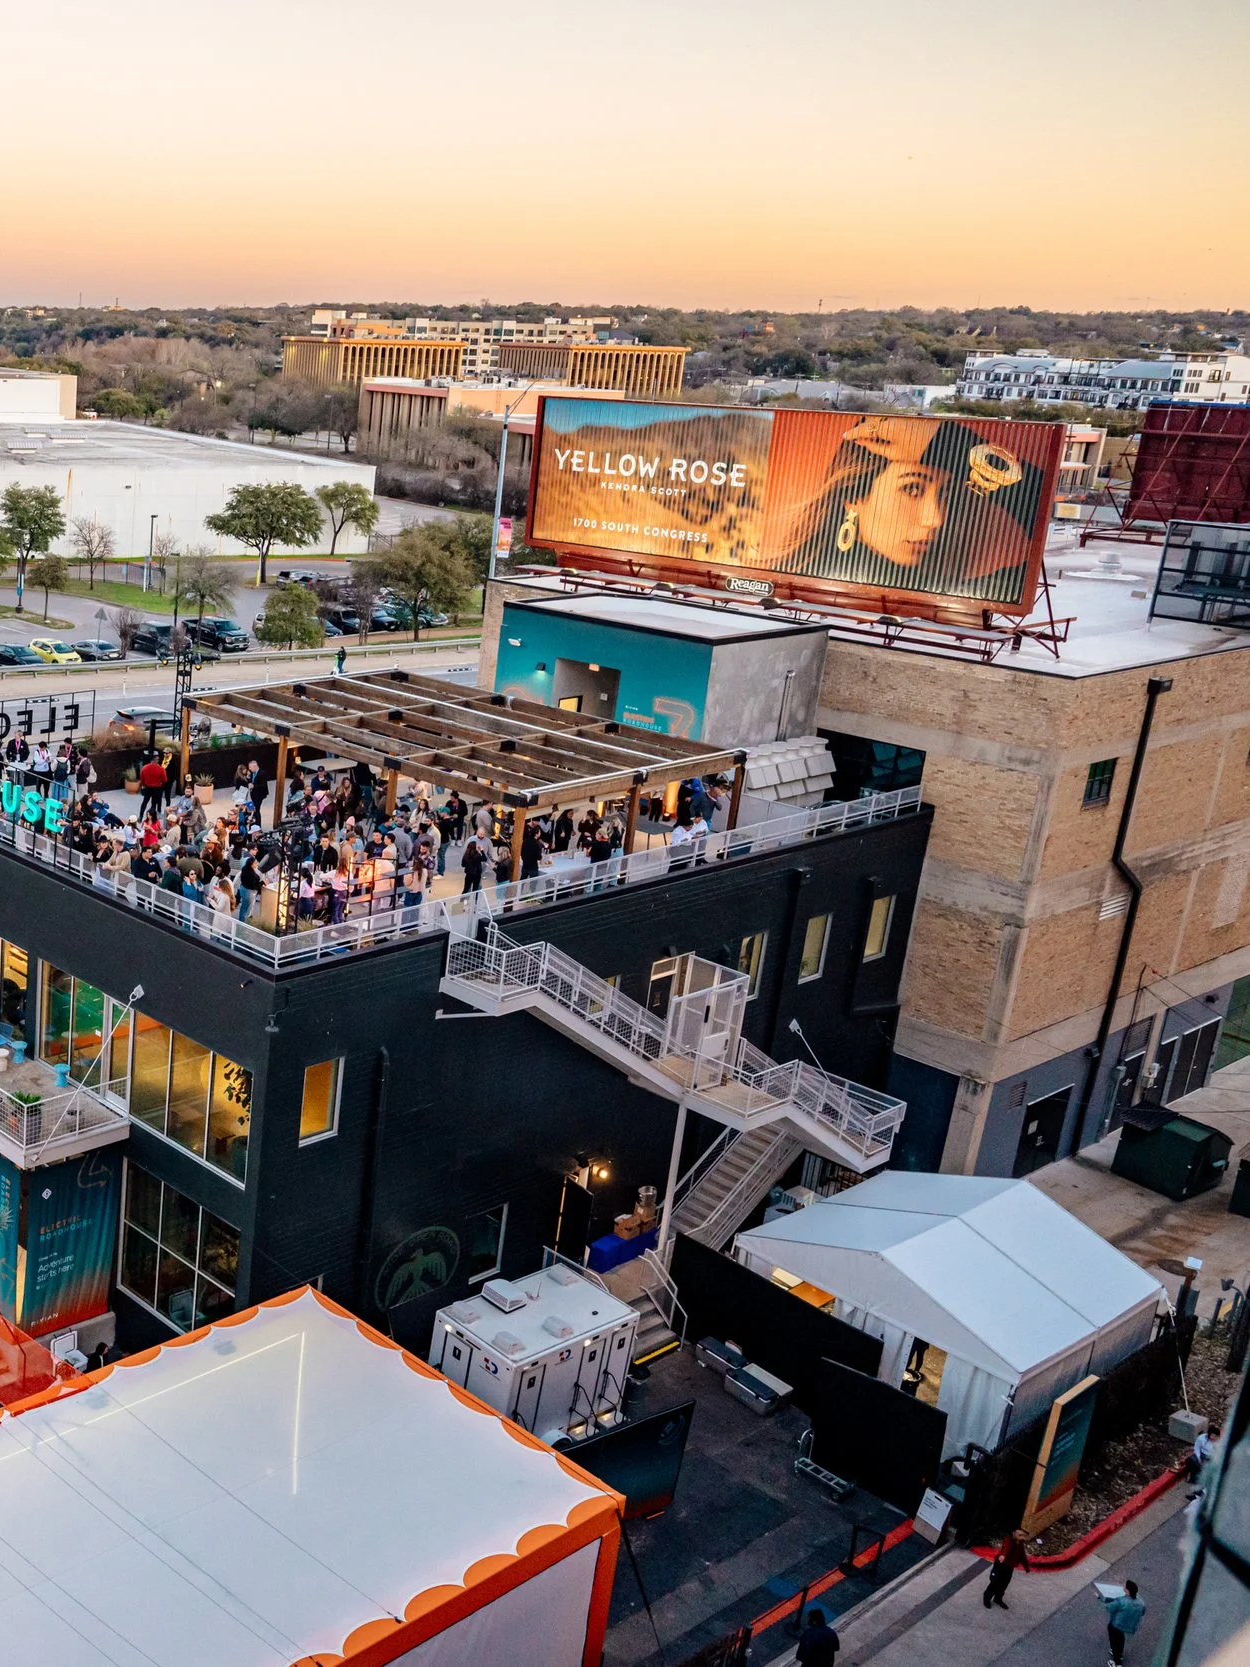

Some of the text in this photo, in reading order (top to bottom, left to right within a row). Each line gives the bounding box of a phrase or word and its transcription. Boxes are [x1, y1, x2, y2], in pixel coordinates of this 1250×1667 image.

[554, 448, 747, 488] YELLOW ROSE
[601, 481, 688, 497] KENDRA SCOTT
[573, 517, 709, 543] 1700 SOUTH CONGRESS
[729, 578, 769, 593] Reagan
[38, 1255, 75, 1273] Adventure
